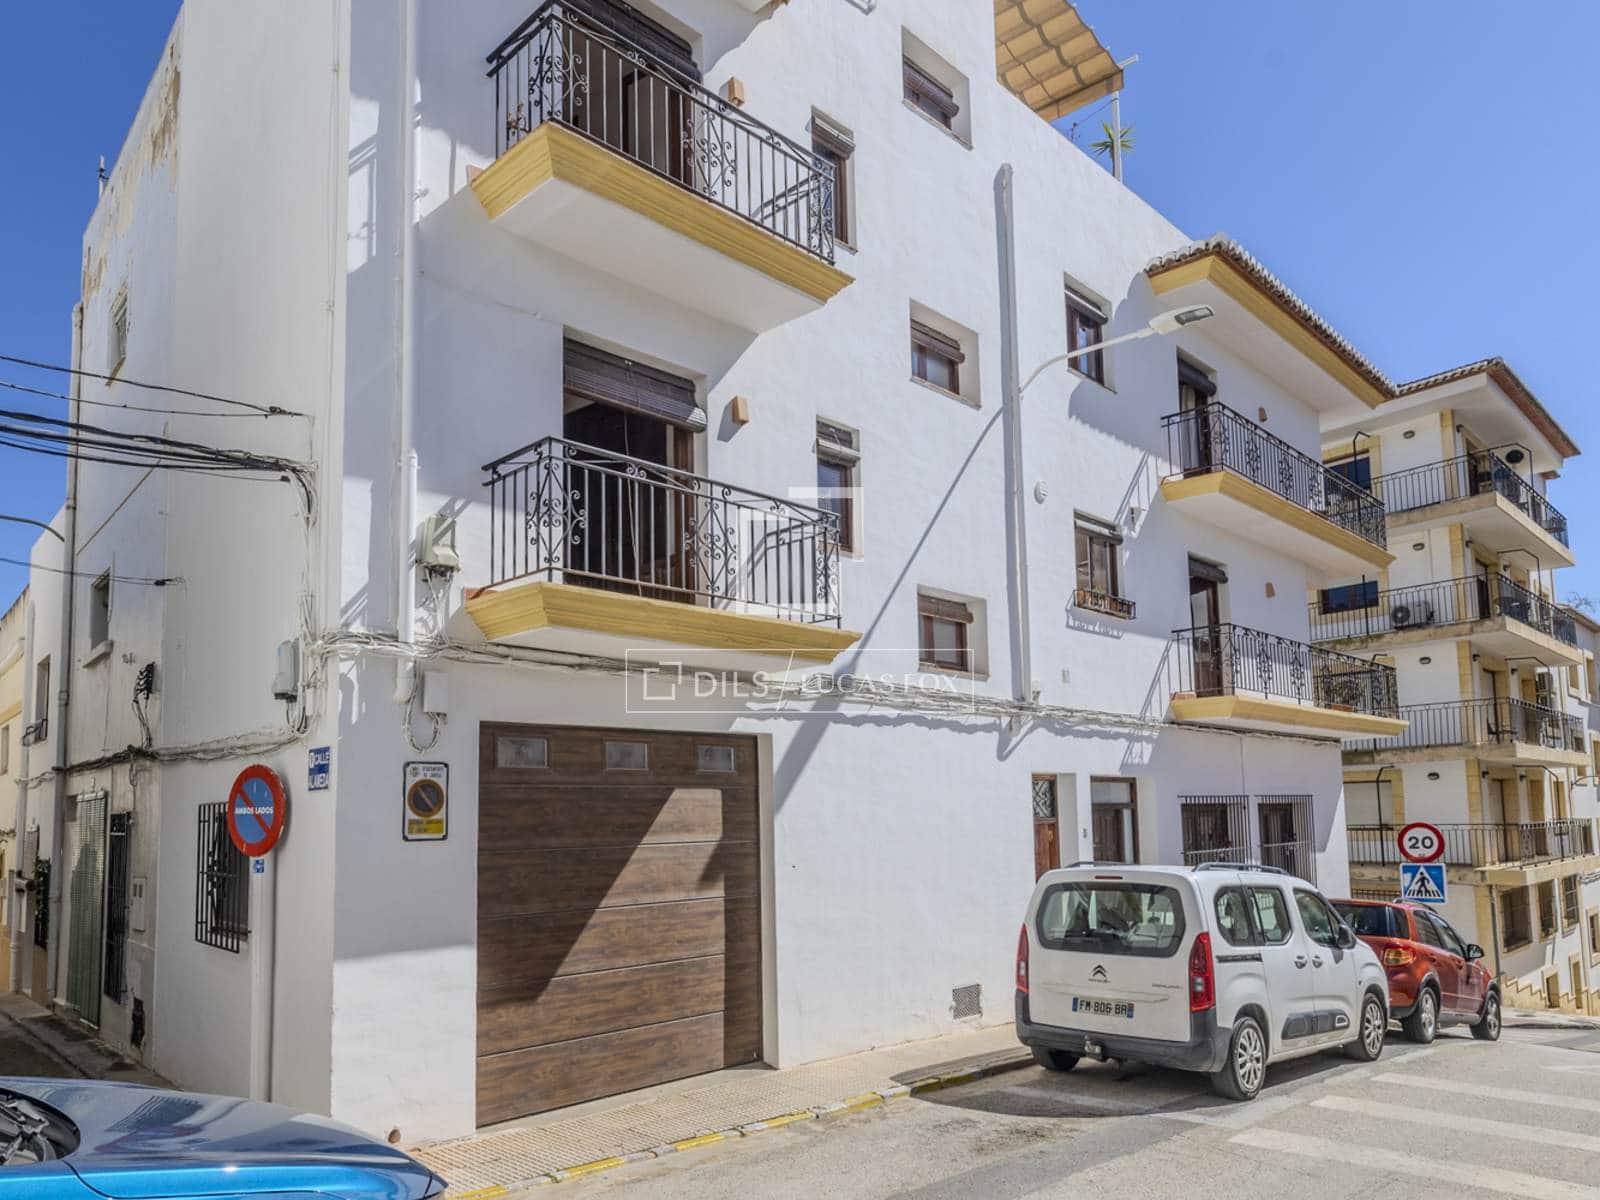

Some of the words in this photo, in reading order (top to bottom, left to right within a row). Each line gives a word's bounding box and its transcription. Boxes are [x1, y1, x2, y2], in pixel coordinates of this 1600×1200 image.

[235, 807, 253, 815] AMBOS
[255, 806, 274, 815] LADOS
[1408, 836, 1434, 850] 20
